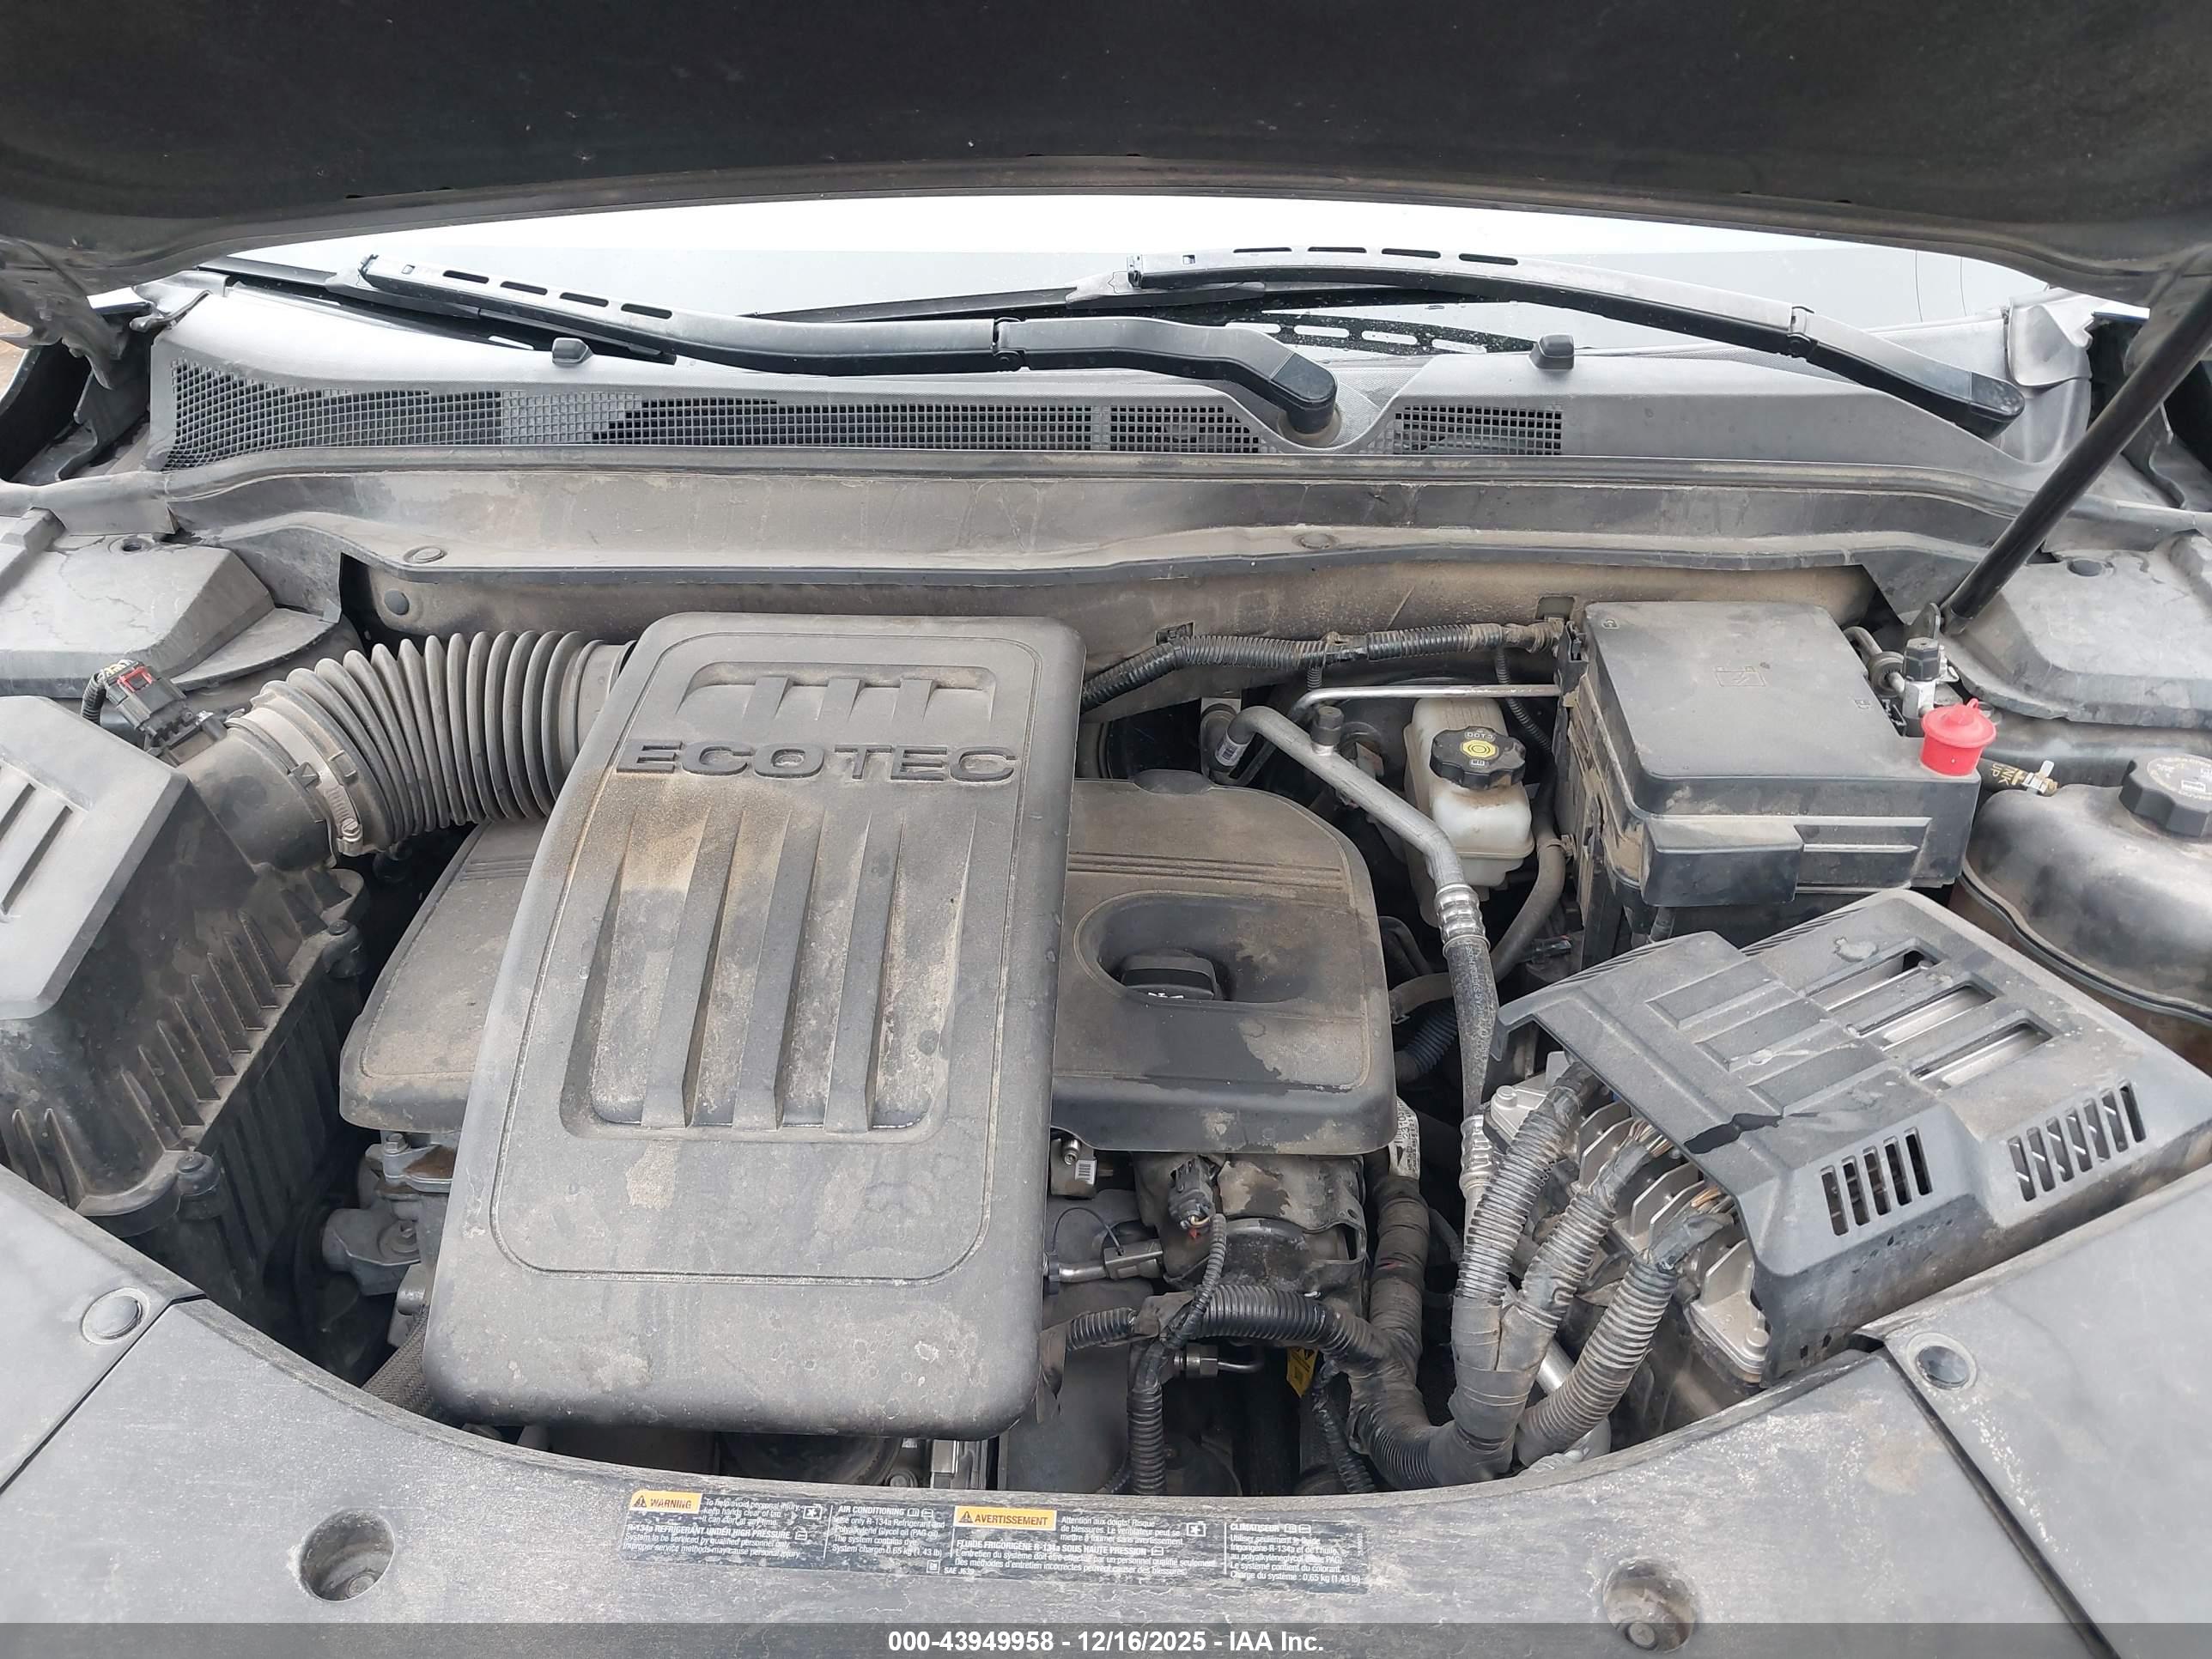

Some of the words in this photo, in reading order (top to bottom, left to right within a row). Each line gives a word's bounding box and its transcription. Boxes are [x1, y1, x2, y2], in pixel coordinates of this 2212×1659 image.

[616, 739, 1017, 783] ECOTEC
[650, 1498, 691, 1509] WARNING
[714, 1499, 729, 1508] help
[750, 1501, 780, 1511] personal
[721, 1508, 742, 1516] hands
[744, 1509, 762, 1517] clear
[837, 1505, 851, 1514] AIR
[852, 1506, 904, 1516] CONDITIONING
[721, 1516, 738, 1525] start
[738, 1516, 746, 1526] at
[747, 1518, 760, 1528] any
[850, 1517, 865, 1526] only
[866, 1517, 892, 1527] R-134a
[893, 1518, 930, 1528] Refrigerant
[975, 1514, 1048, 1526] AVERTISSEMENT
[1061, 1516, 1092, 1525] Attention
[1132, 1519, 1155, 1528] Risque
[627, 1523, 653, 1533] R-134a
[654, 1524, 704, 1534] REFRIGERANT
[706, 1527, 732, 1536] UNDER
[732, 1528, 751, 1537] HIGH
[836, 1525, 877, 1535] Polyalkylene
[878, 1527, 899, 1537] Glycol
[910, 1529, 927, 1539] (PAG
[1060, 1524, 1070, 1533] de
[1117, 1527, 1152, 1536] ventilateur
[1230, 1522, 1280, 1533] CLIMATISEUR
[624, 1533, 650, 1542] System
[701, 1537, 709, 1546] by
[710, 1537, 739, 1546] qualified
[740, 1539, 773, 1548] personnel
[834, 1534, 847, 1543] The
[848, 1535, 872, 1545] system
[873, 1537, 902, 1546] contains
[1060, 1534, 1083, 1542] mettre
[1091, 1534, 1115, 1543] tourner
[1116, 1535, 1133, 1544] sans
[1230, 1534, 1255, 1545] Utiliser
[1255, 1535, 1291, 1545] seulement
[623, 1541, 653, 1553] Improper
[654, 1543, 679, 1552] service
[712, 1547, 726, 1555] may
[750, 1548, 780, 1558] personal
[831, 1544, 857, 1554] System
[903, 1547, 913, 1557] kg
[933, 1548, 943, 1559] lb)
[956, 1539, 983, 1548] FLUIDE
[1034, 1542, 1060, 1553] R-134a
[1061, 1544, 1083, 1553] SOUS
[1083, 1545, 1109, 1554] HAUTE
[1109, 1546, 1147, 1556] PRESSION
[1268, 1544, 1295, 1553] R-134a
[1304, 1546, 1314, 1554] de
[993, 1549, 1002, 1559] du
[1003, 1551, 1032, 1560] système
[1033, 1551, 1047, 1561] doit
[1093, 1555, 1105, 1564] par
[1115, 1557, 1152, 1565] personnel
[944, 1566, 957, 1575] SAE
[958, 1567, 975, 1576] J639
[955, 1558, 969, 1567] Des
[969, 1559, 1004, 1569] méthodes
[1005, 1559, 1042, 1570] d'entretien
[1043, 1561, 1082, 1571] incorrectes
[1083, 1564, 1112, 1573] peuvent
[1112, 1565, 1136, 1574] causer
[1137, 1565, 1151, 1574] des
[1230, 1561, 1239, 1570] Le
[1271, 1563, 1300, 1572] contient
[1301, 1564, 1310, 1572] du
[1230, 1571, 1255, 1581] Charge
[1257, 1571, 1267, 1580] du
[1303, 1573, 1320, 1583] 0.65
[1320, 1574, 1330, 1583] kg
[1351, 1575, 1361, 1585] lb)
